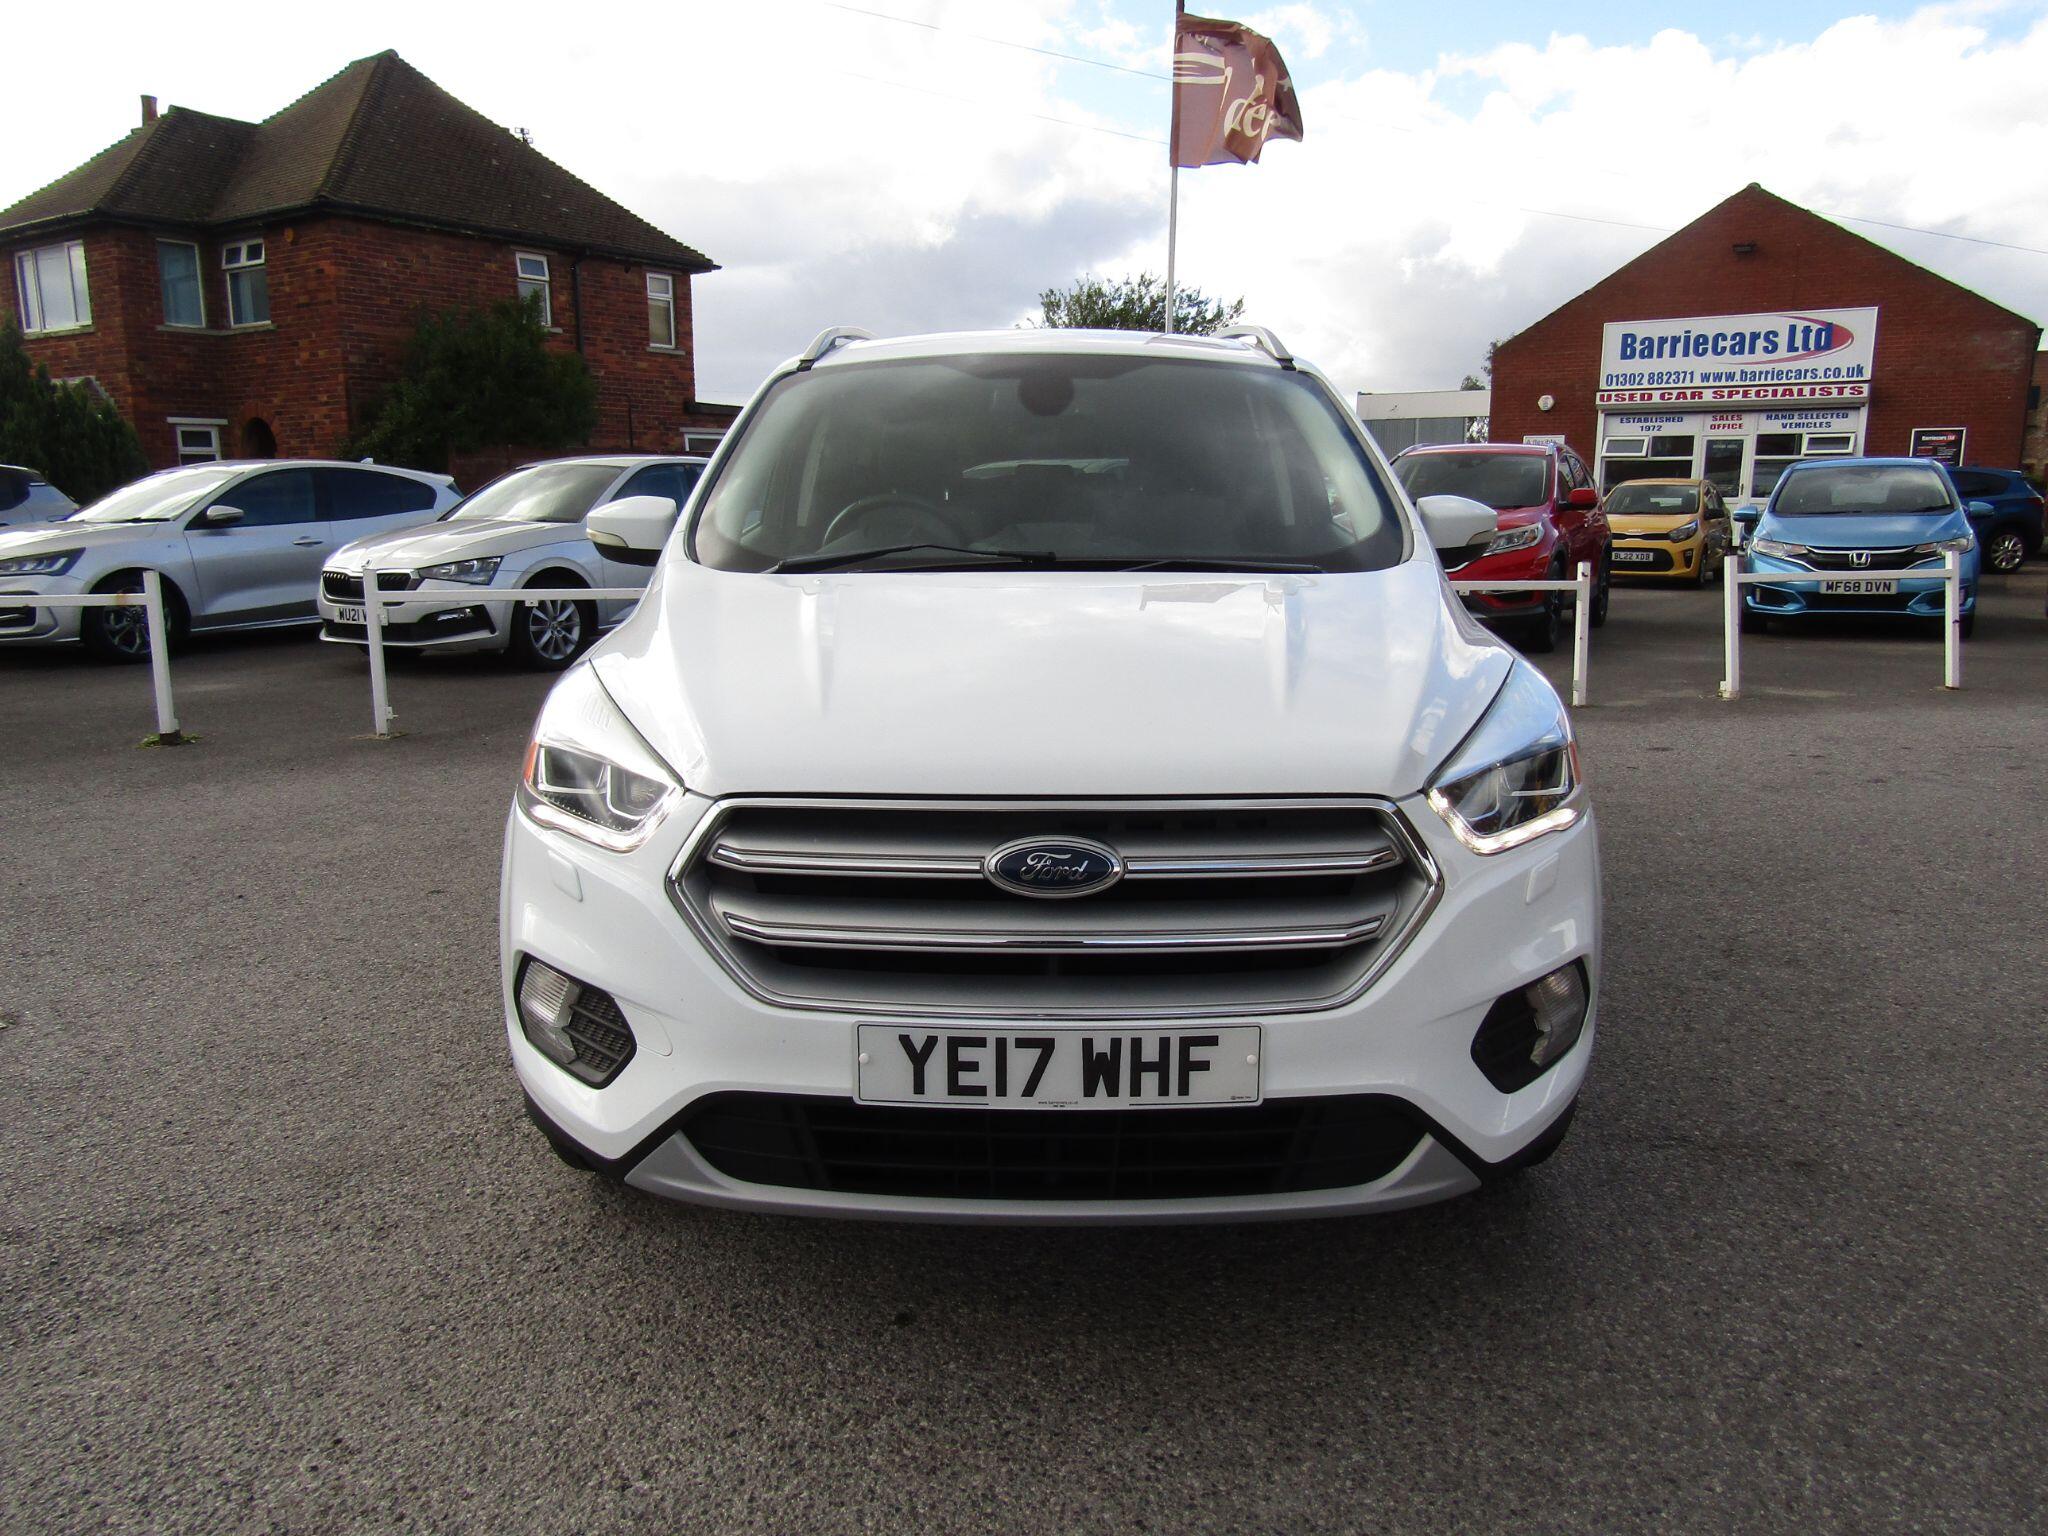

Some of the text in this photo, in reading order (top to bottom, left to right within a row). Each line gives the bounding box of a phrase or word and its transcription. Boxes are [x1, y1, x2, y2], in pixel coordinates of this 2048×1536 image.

[1620, 321, 1833, 360] Barriecars Ltd
[1606, 363, 1864, 387] 01302 882371 www.barriecars.co.uk
[1599, 385, 1865, 403] USED CAR SPECIALISTS
[1619, 416, 1684, 424] ESTABLISHED
[1711, 414, 1743, 422] SALES
[1765, 411, 1849, 421] HAND SELECTED
[1639, 424, 1662, 432] 1972
[1709, 422, 1744, 430] OFFICE
[1781, 420, 1832, 429] VEHICLES
[1825, 581, 1892, 593] MF68 DVN
[339, 607, 360, 621] WU21
[1019, 852, 1089, 881] Ford
[898, 1034, 1219, 1098] YE17 WHF
